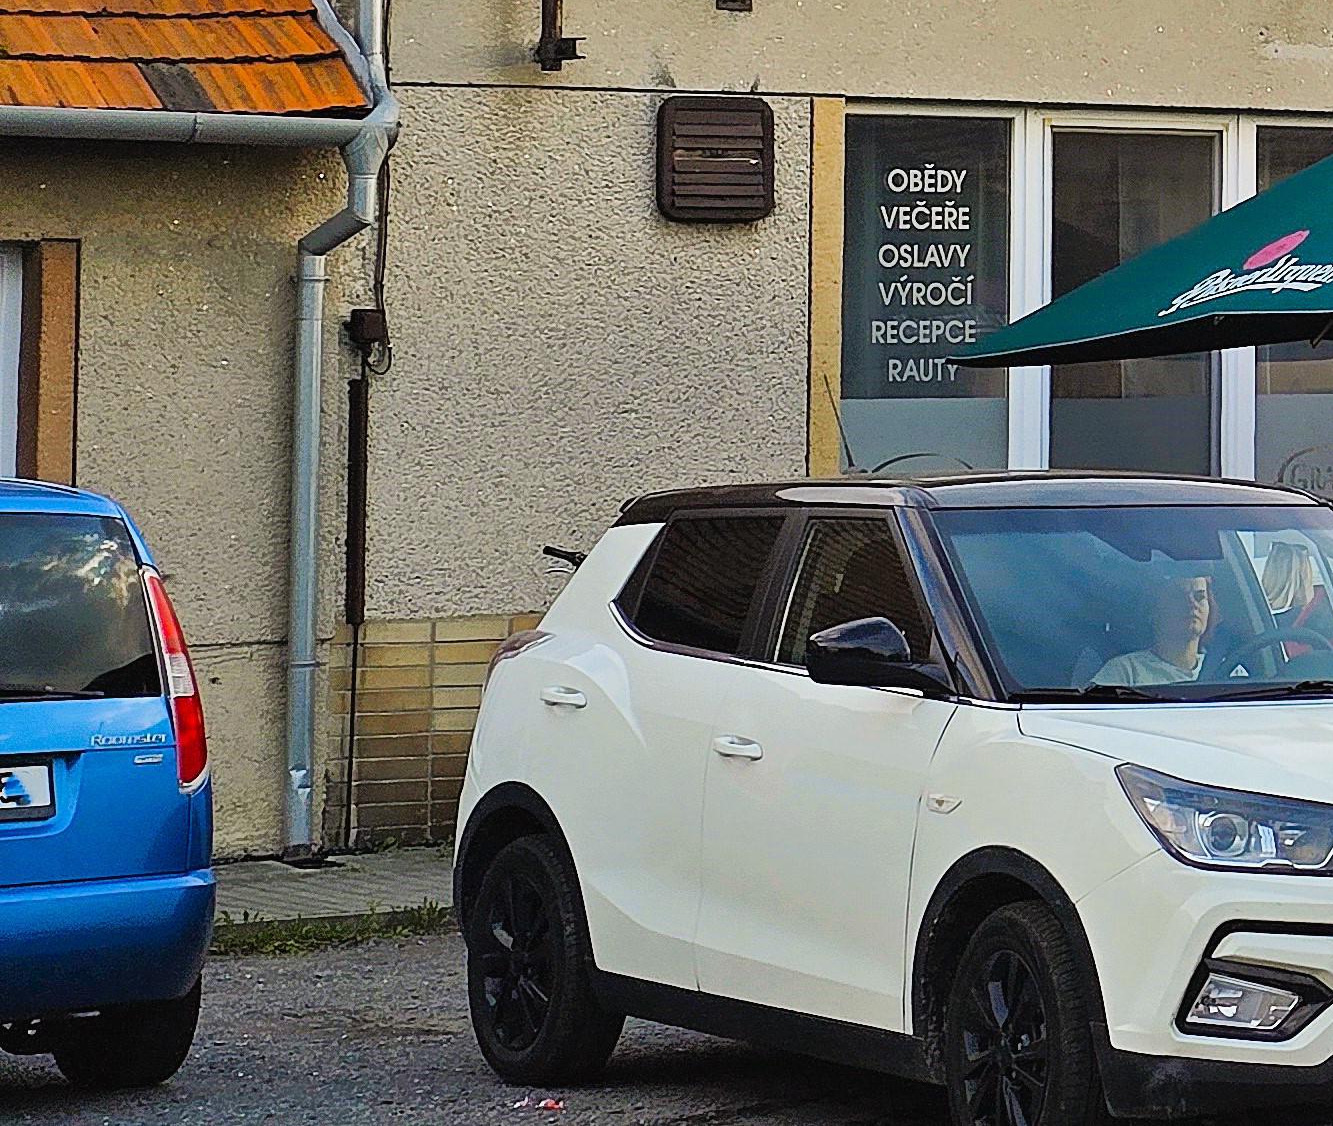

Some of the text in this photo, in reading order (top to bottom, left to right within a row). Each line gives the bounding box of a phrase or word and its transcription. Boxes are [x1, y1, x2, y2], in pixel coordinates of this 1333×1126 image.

[887, 163, 967, 193] OBĚDY
[880, 200, 970, 230] VEČEŘE
[878, 243, 971, 268] OSLAVY
[878, 274, 975, 306] VÝROČÍ
[871, 320, 977, 344] RECEPCE
[888, 358, 959, 382] RAUTY
[90, 733, 167, 747] Roomster
